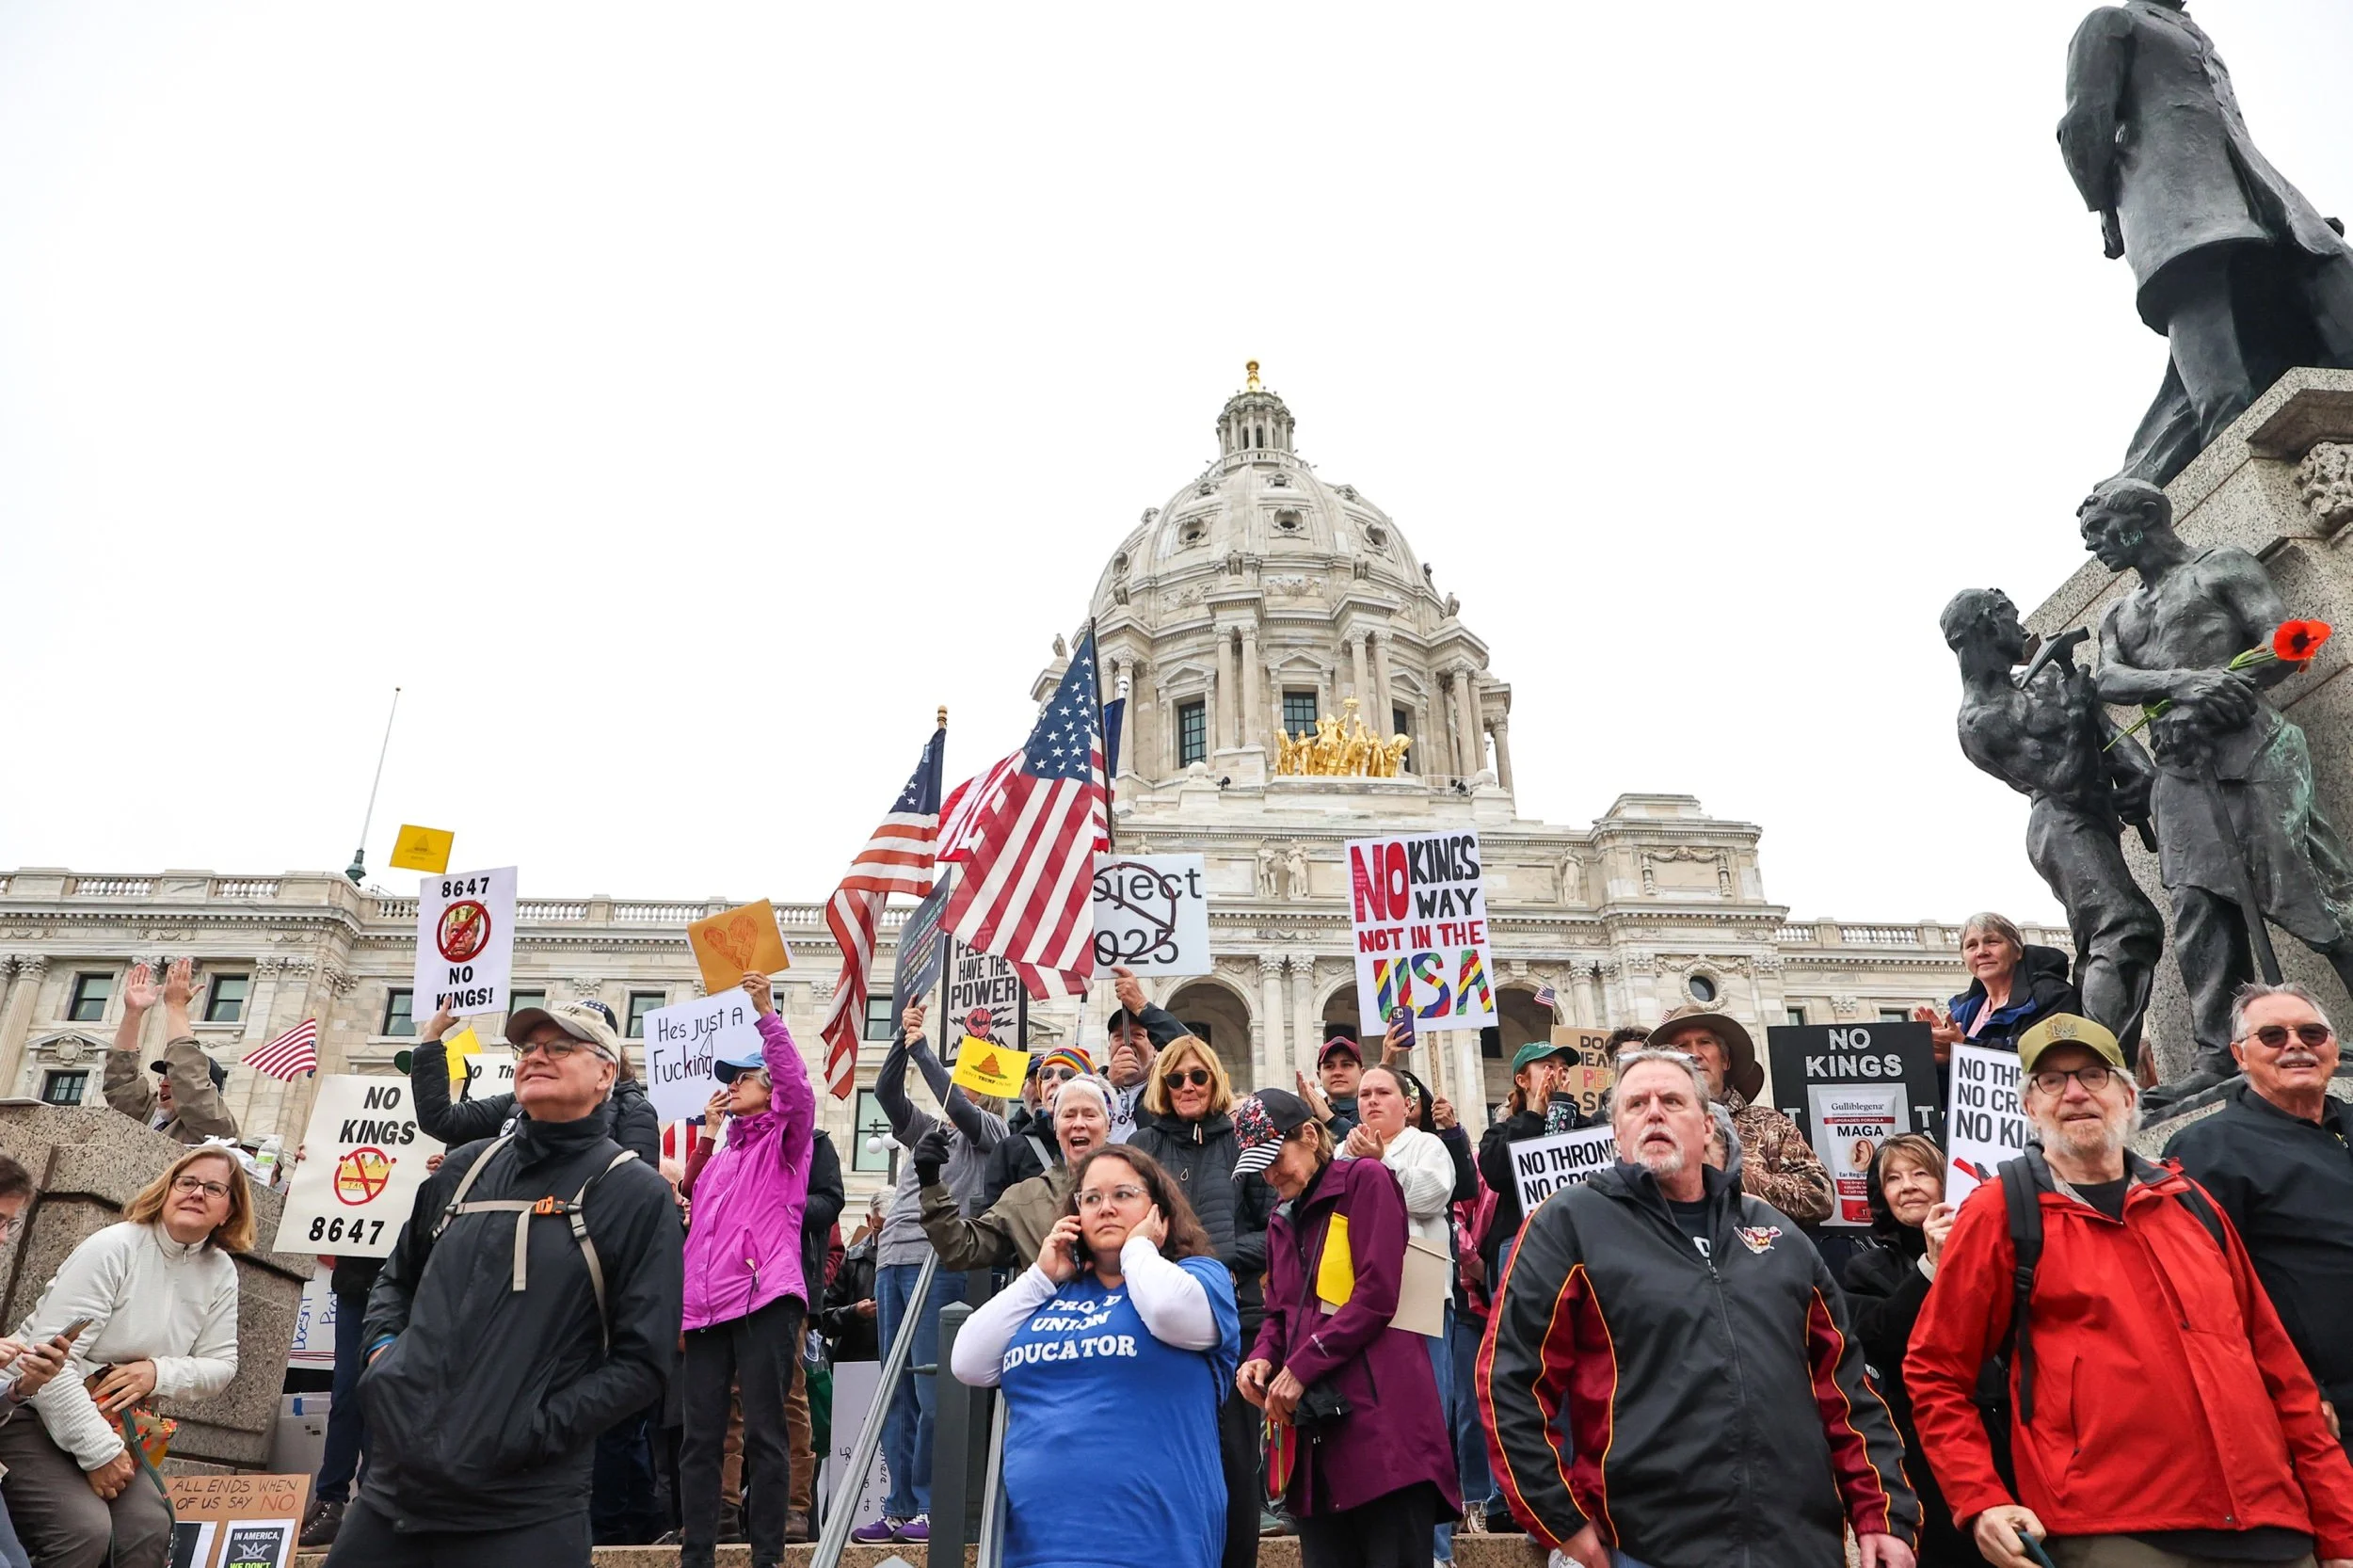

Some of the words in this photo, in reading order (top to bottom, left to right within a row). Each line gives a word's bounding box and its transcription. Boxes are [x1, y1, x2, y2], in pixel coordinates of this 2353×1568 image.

[441, 876, 490, 898] 8647
[1094, 865, 1202, 910] oject
[1351, 841, 1410, 923] NO
[1407, 835, 1481, 885] KINGS
[1415, 887, 1479, 920] WAY
[1094, 928, 1179, 967] 025
[1358, 926, 1404, 953] NOT
[1410, 924, 1433, 949] IN
[1437, 920, 1485, 947] THE
[448, 966, 473, 985] NO
[958, 956, 984, 982] HAVE
[989, 954, 1010, 977] THE
[951, 976, 1017, 1010] POWER
[1373, 949, 1495, 1023] USA
[658, 1017, 686, 1042] He's
[732, 1006, 743, 1026] A
[1828, 1028, 1871, 1051] NO
[471, 1065, 482, 1080] O
[653, 1045, 712, 1085] Fucking
[1804, 1054, 1903, 1078] KINGS
[1959, 1057, 1985, 1081] NO
[363, 1086, 401, 1110] NO
[1958, 1082, 1985, 1108] NO
[1992, 1089, 2026, 1116] CR
[339, 1119, 417, 1144] KINGS
[1837, 1125, 1884, 1137] MAGA
[1956, 1109, 1993, 1143] NO
[1518, 1151, 1545, 1176] NO
[1524, 1177, 1552, 1205] NO
[309, 1216, 385, 1245] 8647
[1047, 1294, 1122, 1314] PROD
[1032, 1310, 1112, 1332] UNION
[1002, 1335, 1138, 1373] EDUCATOR
[173, 1480, 202, 1493] ALL
[207, 1479, 251, 1494] ENDS
[258, 1479, 298, 1493] WHEN
[176, 1496, 198, 1510] OF
[201, 1496, 221, 1510] US
[228, 1496, 253, 1510] SAY
[233, 1531, 243, 1541] IN
[243, 1531, 280, 1542] AMERICA,
